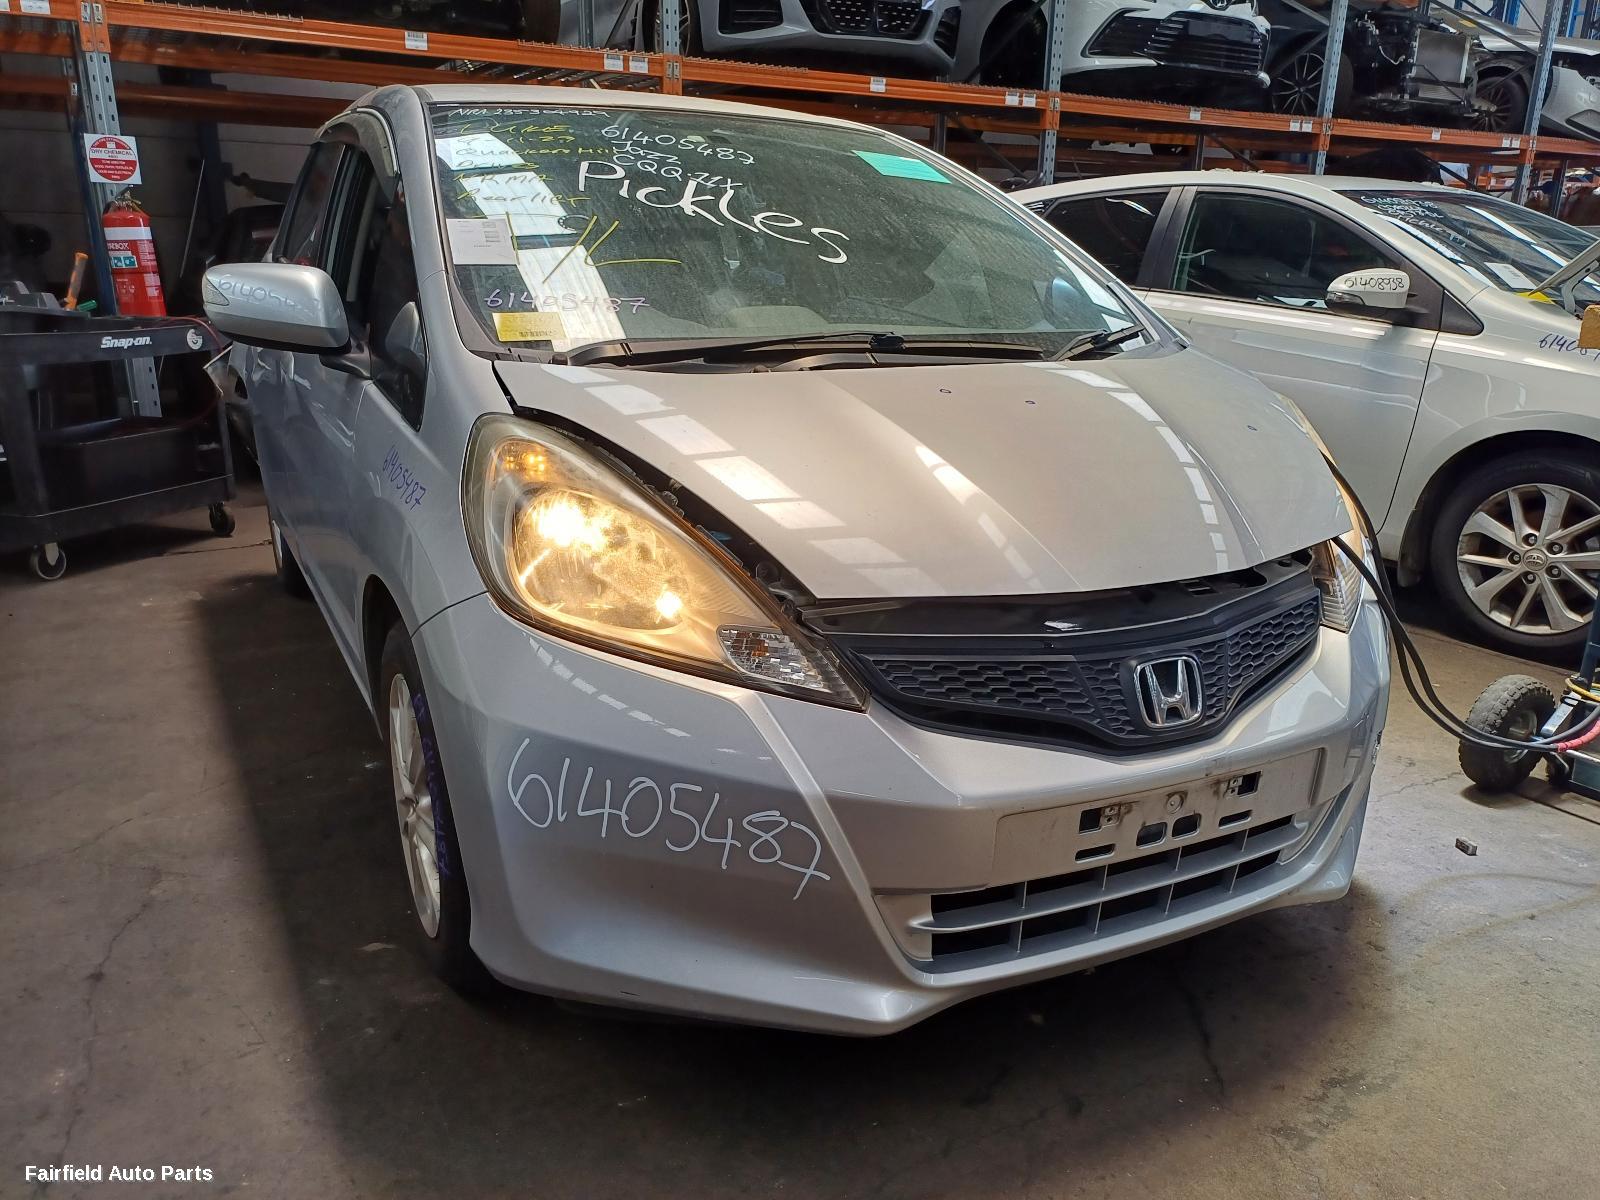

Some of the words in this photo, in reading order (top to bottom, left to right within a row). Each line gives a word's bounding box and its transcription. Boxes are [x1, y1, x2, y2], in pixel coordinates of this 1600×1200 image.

[601, 125, 755, 165] 61405487
[578, 160, 850, 264] Pickles
[484, 288, 650, 314] 61405487
[507, 737, 831, 901] 61405487
